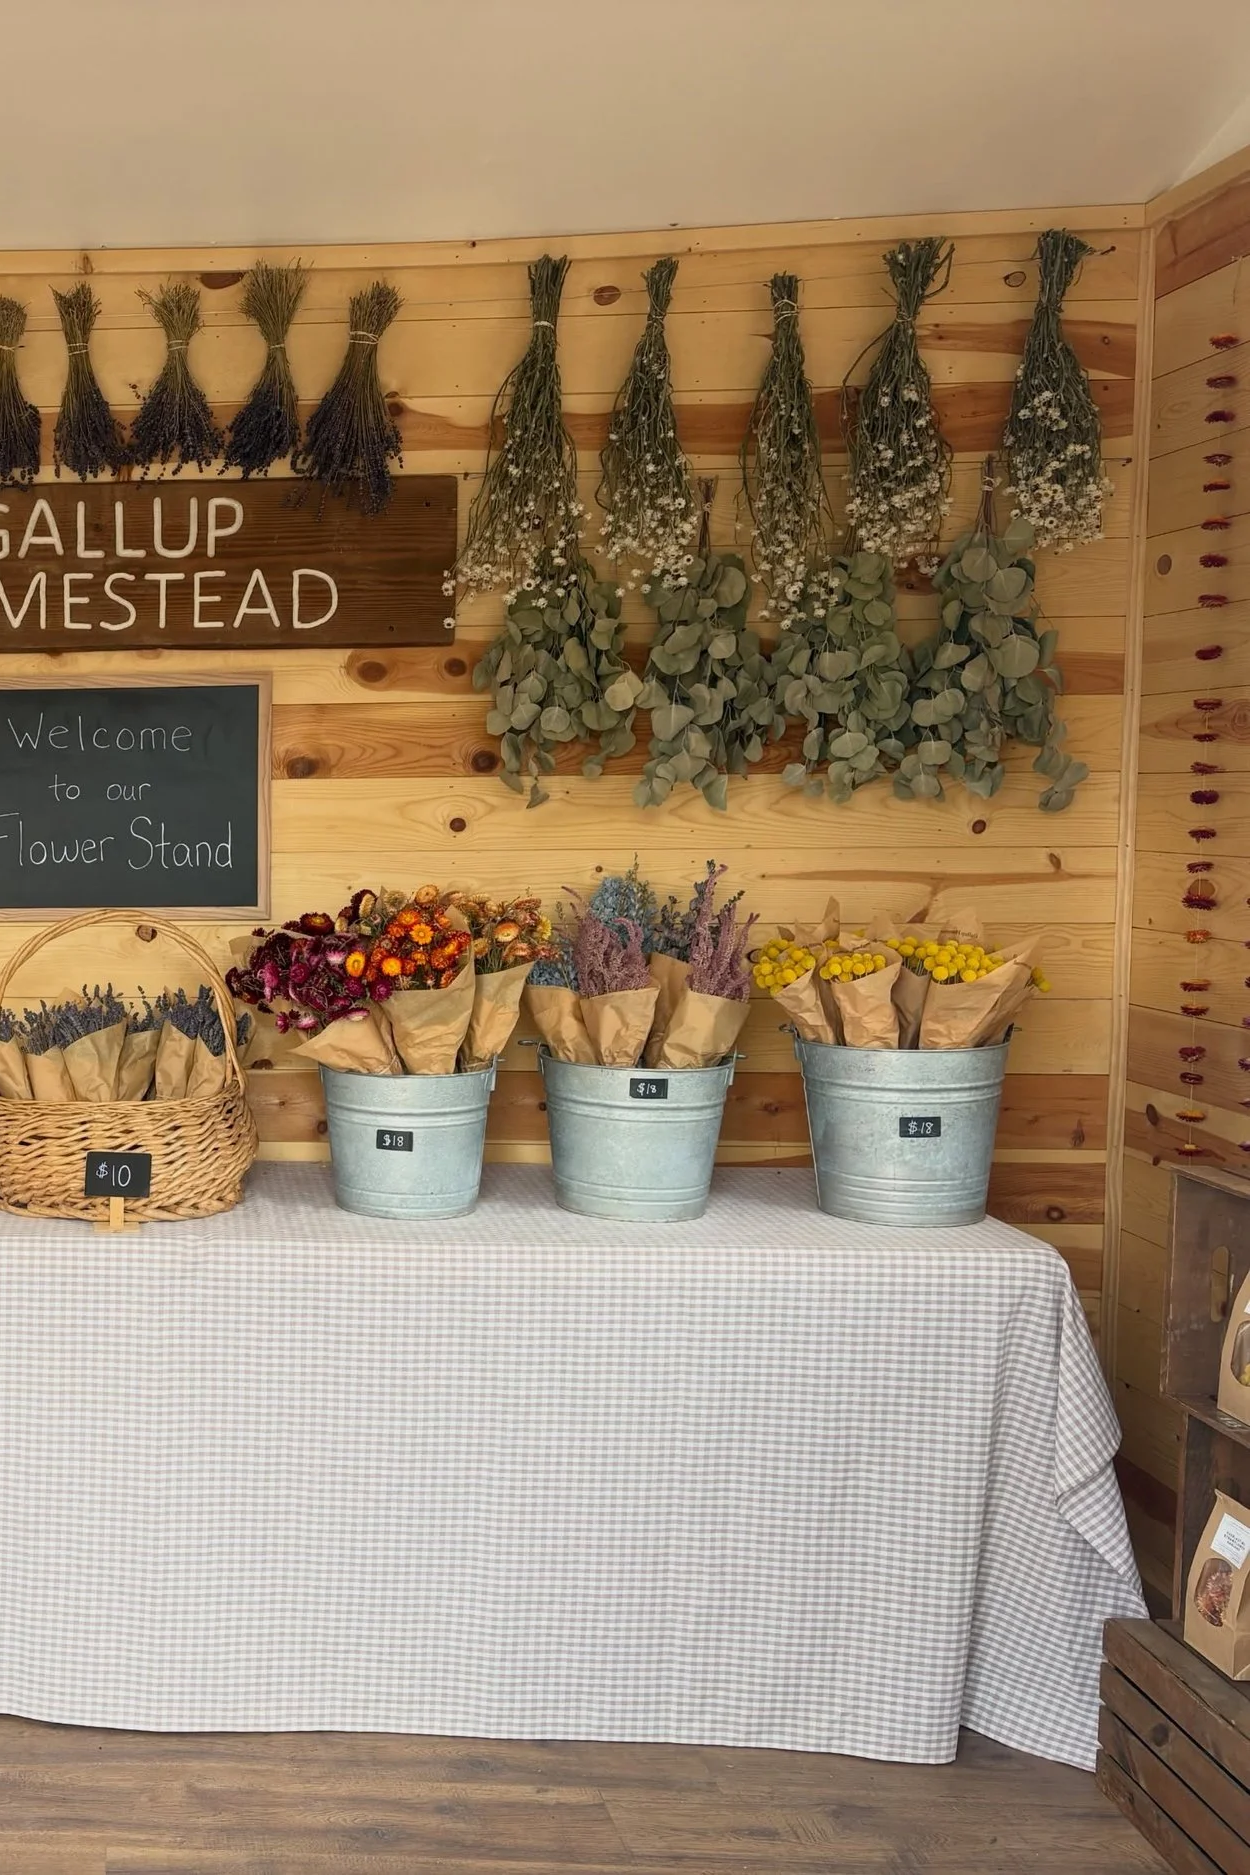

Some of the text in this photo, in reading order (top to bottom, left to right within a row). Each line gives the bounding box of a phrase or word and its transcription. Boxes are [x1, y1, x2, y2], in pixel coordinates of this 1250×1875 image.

[7, 712, 192, 751] Welcome
[48, 774, 151, 802] to our
[128, 815, 233, 870] Stand
[636, 1082, 657, 1096] $18
[382, 1134, 404, 1146] $18
[908, 1120, 934, 1134] $18
[95, 1161, 131, 1187] $10
